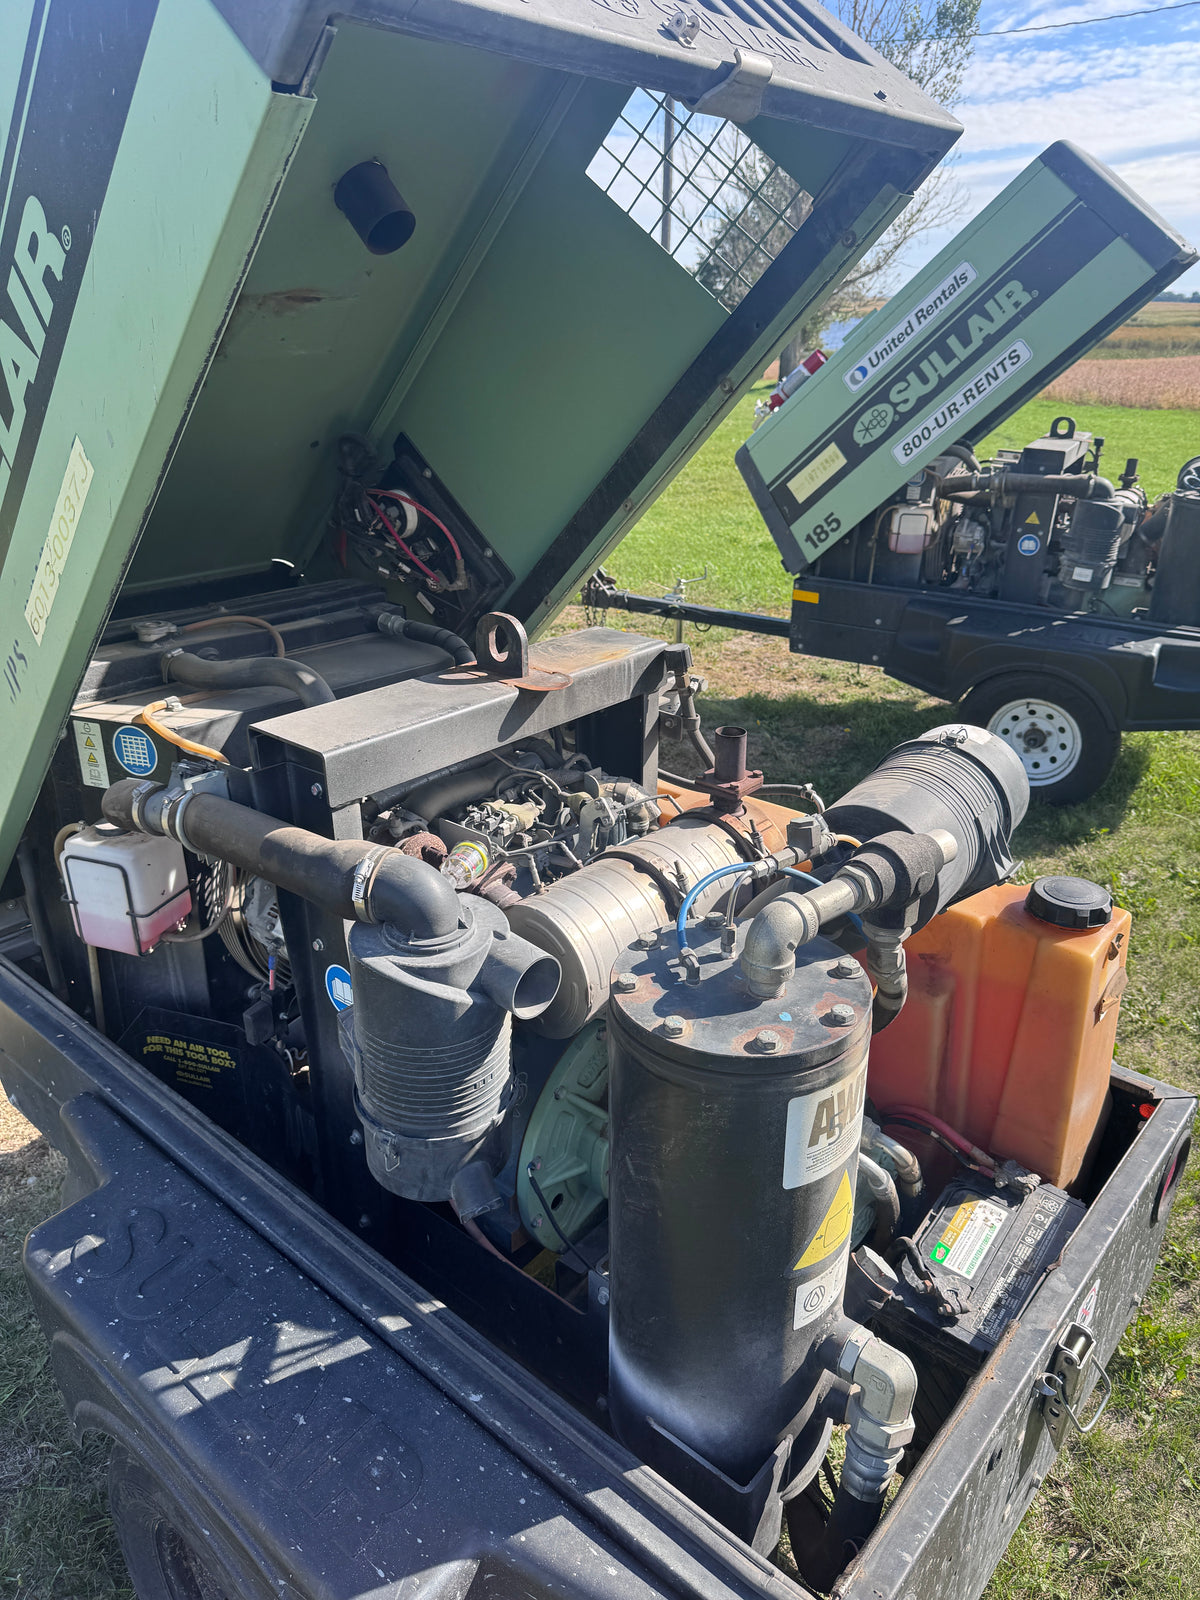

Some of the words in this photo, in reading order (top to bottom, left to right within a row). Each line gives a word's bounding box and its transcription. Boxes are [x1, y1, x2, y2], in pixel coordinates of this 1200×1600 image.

[868, 321, 915, 368] United
[915, 271, 968, 326] Rentals
[889, 280, 1032, 413] SULLAIR
[902, 349, 1021, 457] 800-UR-RENTS
[805, 512, 841, 549] 185
[143, 1045, 163, 1054] FOR
[164, 1046, 184, 1056] THIS
[185, 1050, 210, 1062] TOOL
[211, 1057, 236, 1069] BOX?
[146, 1036, 171, 1045] NEED
[173, 1040, 187, 1049] AN
[189, 1044, 205, 1053] AIR
[206, 1047, 231, 1059] TOOL
